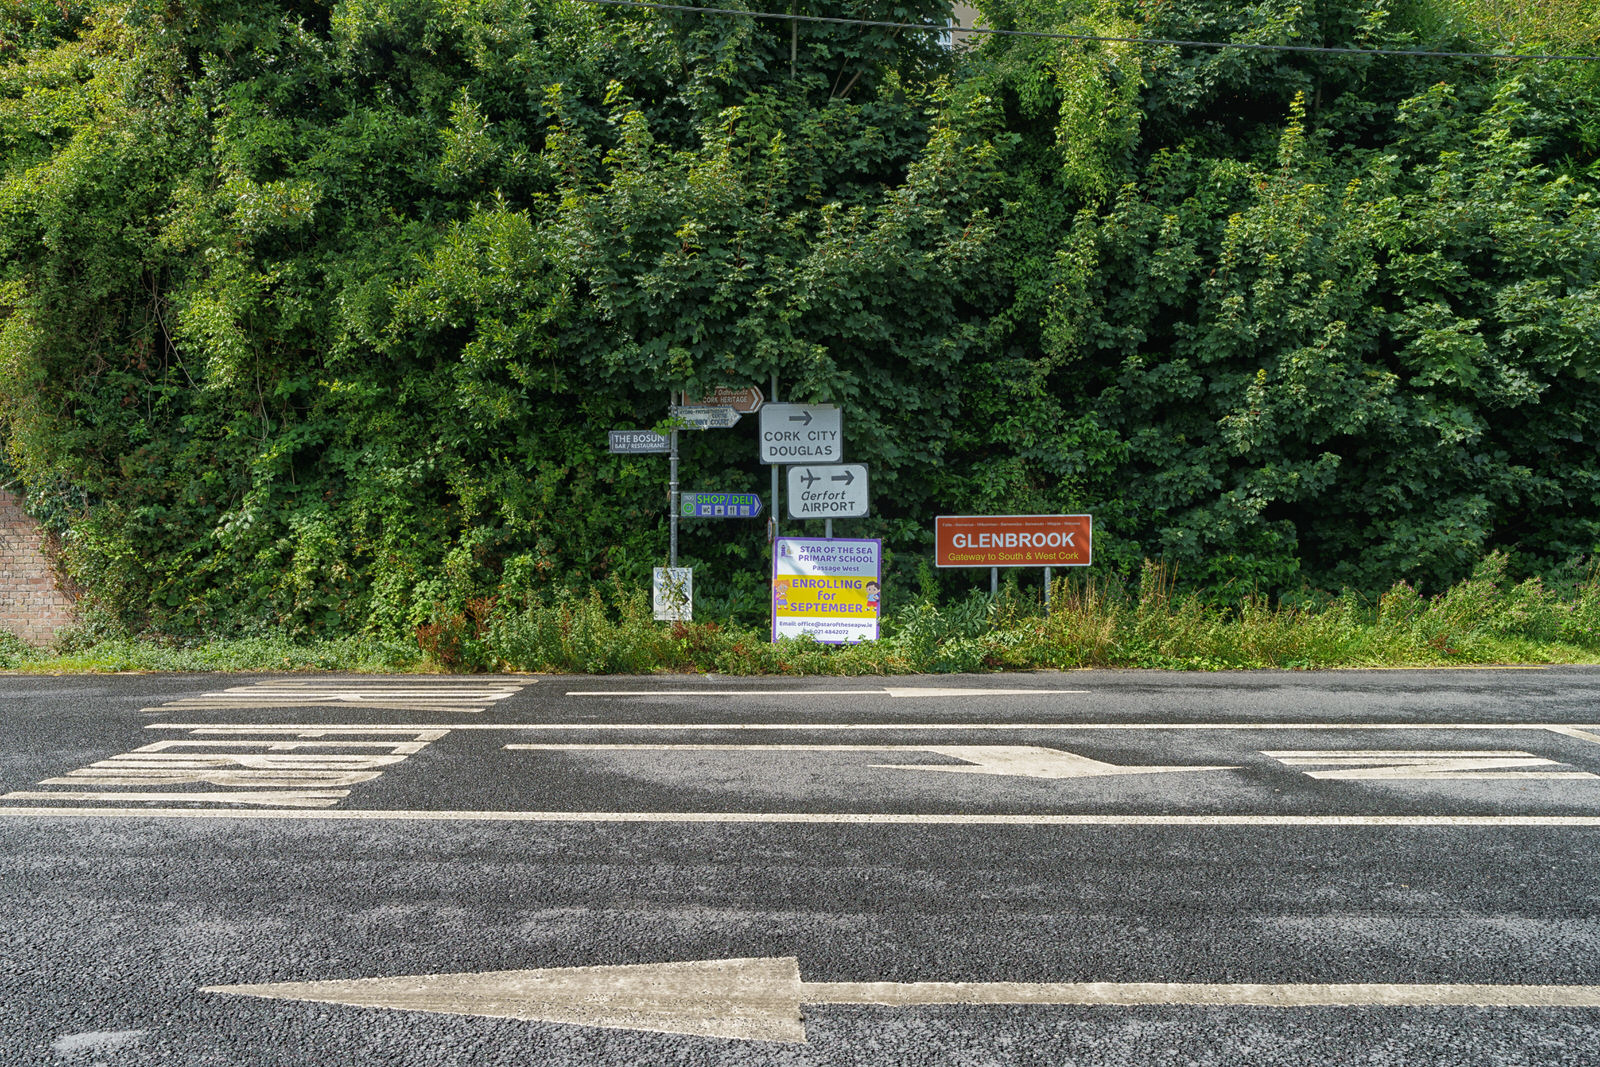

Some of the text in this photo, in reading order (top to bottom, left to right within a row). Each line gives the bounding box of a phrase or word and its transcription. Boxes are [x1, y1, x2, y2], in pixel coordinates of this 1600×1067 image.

[703, 396, 748, 404] CORK HERITAGE
[614, 434, 665, 443] THE BOSUN
[764, 430, 838, 442] CORK CITY
[769, 445, 833, 457] DOUGLAS
[732, 495, 753, 505] DELI
[801, 501, 856, 512] AIRPORT
[952, 532, 1076, 549] GLENBROOK
[800, 545, 873, 555] STAR OF THE SEA
[798, 555, 874, 563] PRIMARY SCHOOL
[948, 551, 1079, 562] Gateway to South & West Cork
[792, 579, 862, 590] ENROLLING
[817, 590, 837, 600] for
[790, 602, 863, 613] SEPTEMBER
[0, 729, 451, 808] FERRY
